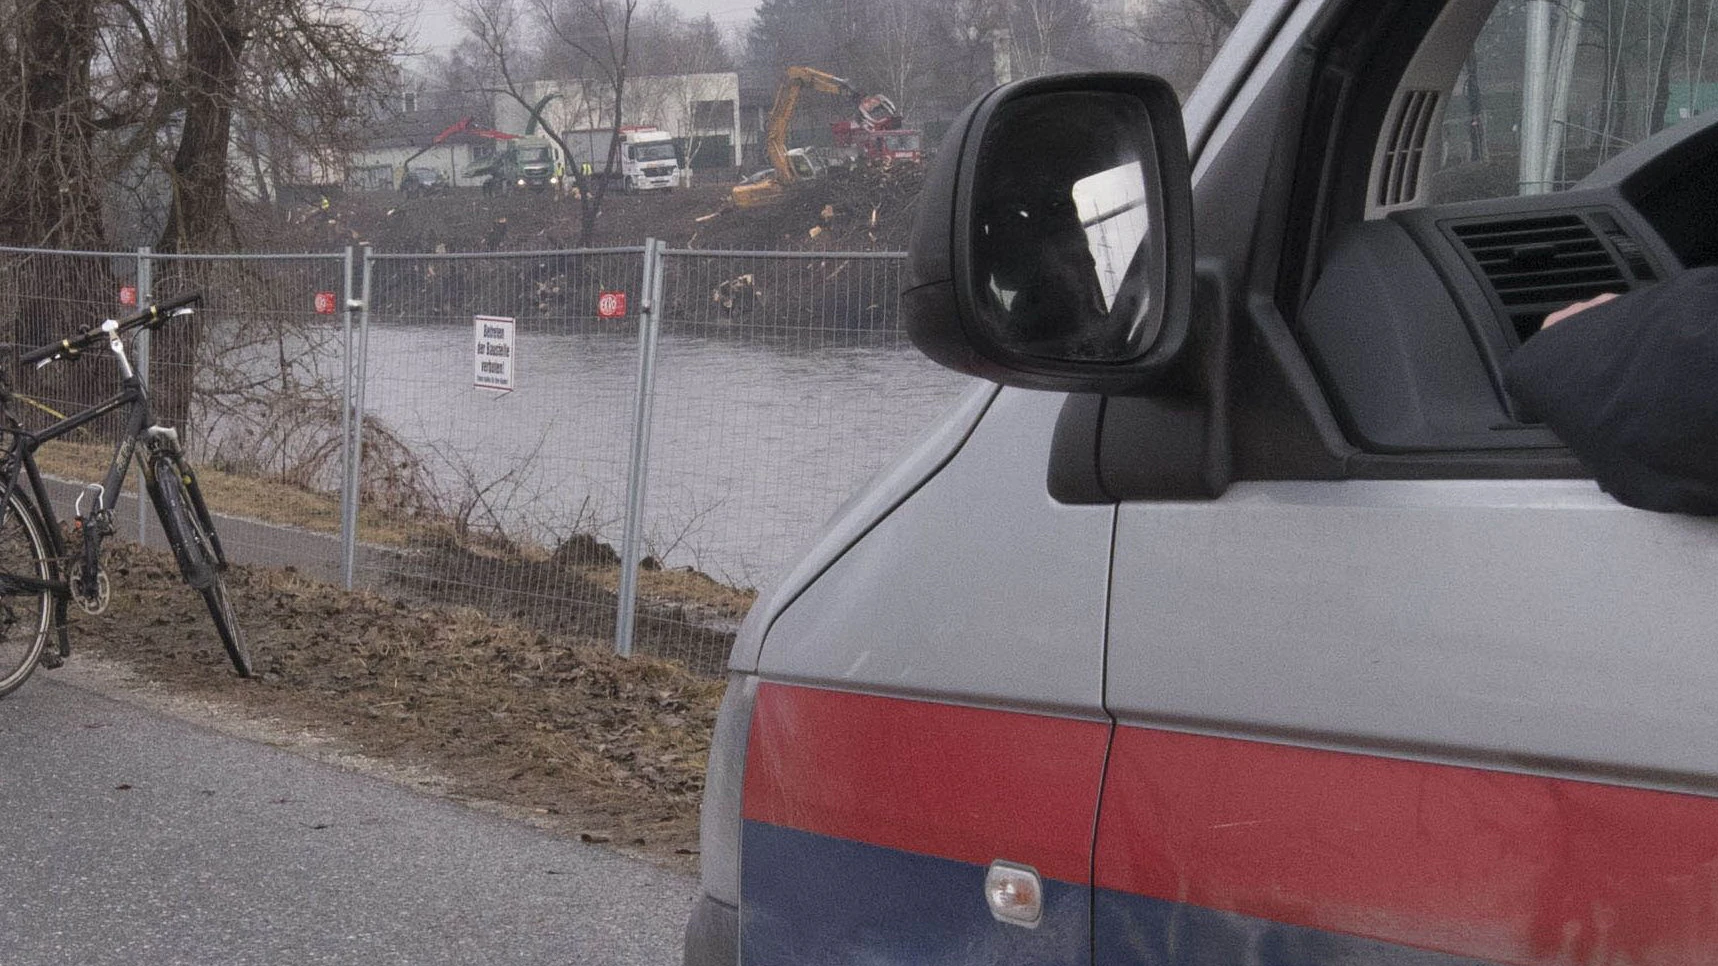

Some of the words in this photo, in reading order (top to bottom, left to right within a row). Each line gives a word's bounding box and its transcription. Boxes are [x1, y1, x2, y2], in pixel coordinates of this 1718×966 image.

[483, 324, 505, 339] Betreten
[477, 341, 486, 355] der
[486, 342, 510, 357] Baustelle
